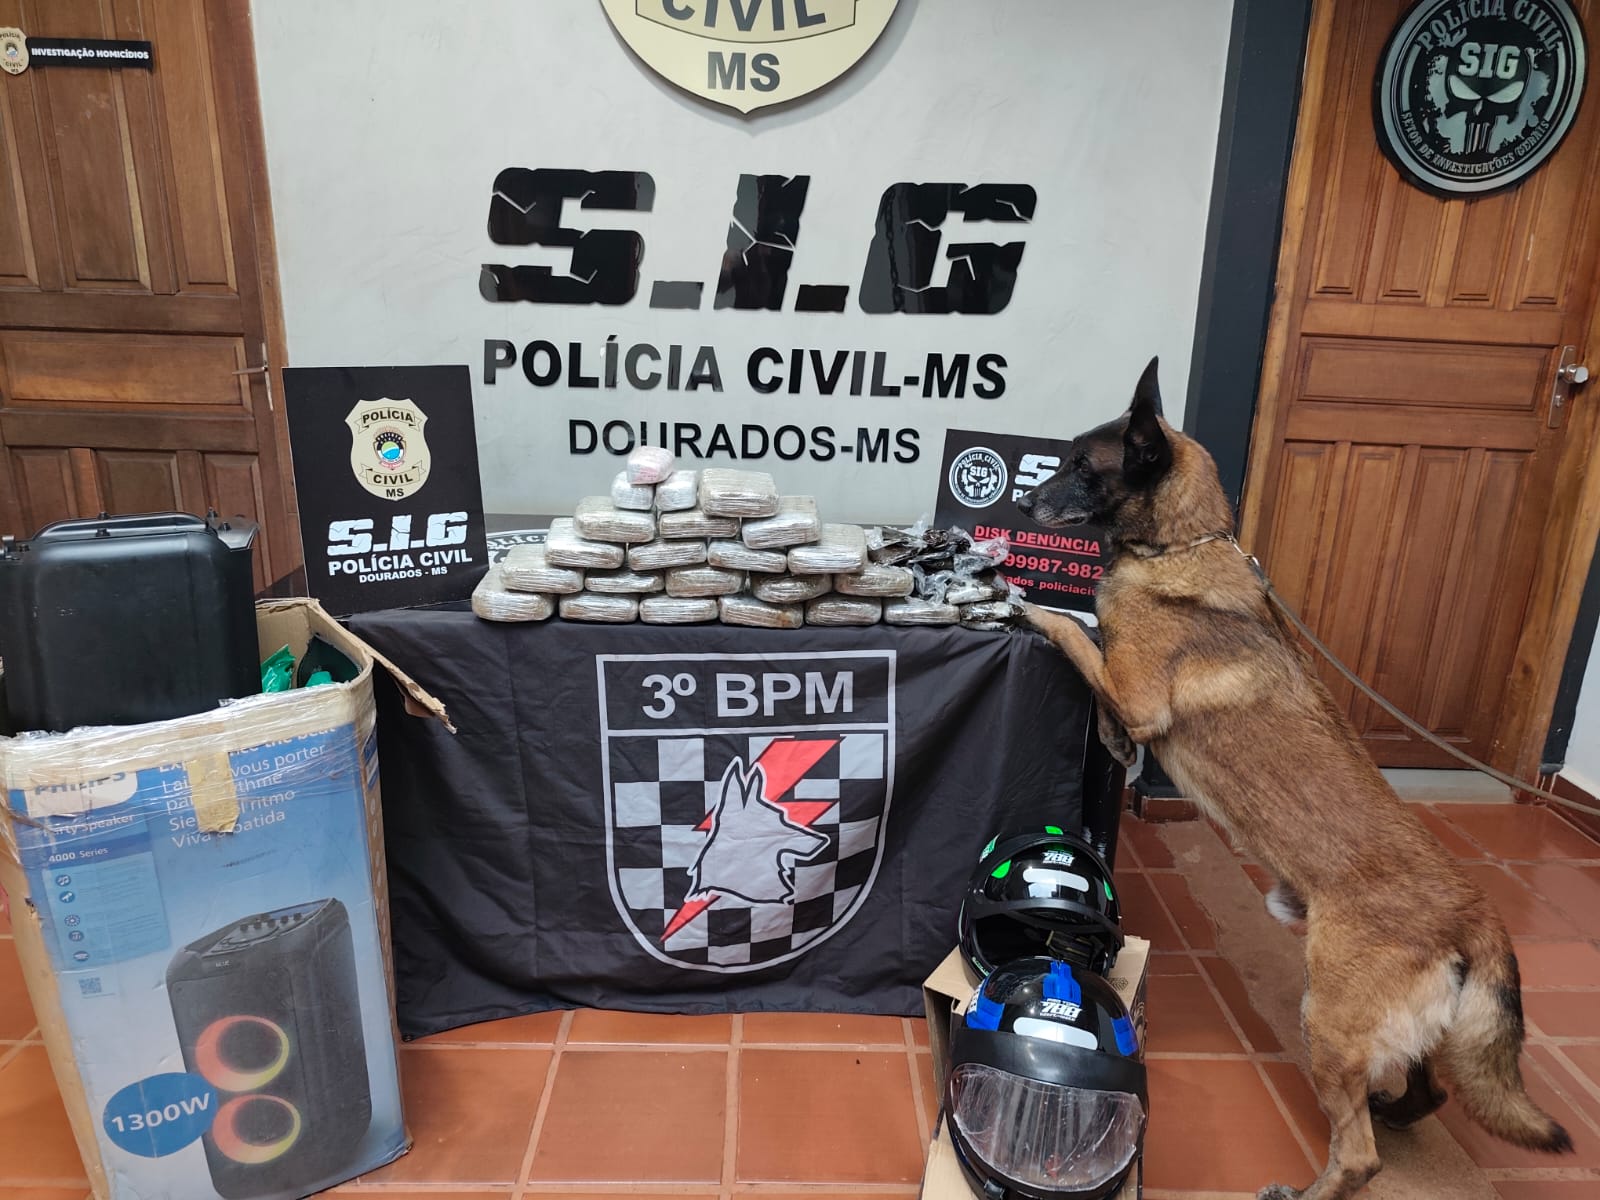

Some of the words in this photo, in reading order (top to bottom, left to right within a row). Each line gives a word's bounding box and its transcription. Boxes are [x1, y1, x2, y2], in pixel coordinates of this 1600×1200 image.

[662, 0, 827, 32] CIVIL
[1416, 0, 1507, 51] POLÍCIA
[1513, 0, 1564, 51] CIVIL
[31, 47, 95, 60] INVESTIGAÇÃO
[96, 48, 149, 59] HOMICÍDIOS
[1458, 42, 1520, 79] SIG
[707, 51, 781, 92] MS
[1400, 110, 1423, 148] SETOR
[1420, 144, 1433, 160] DE
[483, 335, 724, 393] POLÍCIA
[746, 347, 1008, 399] CIVIL-MS
[362, 408, 414, 424] POLÍCIA
[568, 419, 921, 463] DOURADOS-MS
[373, 473, 414, 485] CIVIL
[970, 466, 988, 477] SIG
[386, 488, 404, 498] MS
[975, 525, 1012, 540] DISK
[1016, 531, 1100, 553] DENÚNCIA
[328, 554, 414, 576] POLÍCIA
[419, 549, 473, 566] CIVIL
[359, 569, 422, 583] DOURADOS
[431, 566, 448, 576] MS
[1004, 553, 1104, 580] 99987-982
[716, 671, 854, 718] BPM
[274, 744, 325, 769] porter
[251, 790, 296, 811] ritmo
[81, 814, 135, 832] Speaker
[172, 832, 212, 849] Viva
[48, 852, 76, 862] 4000
[80, 847, 109, 858] Series
[111, 1093, 210, 1134] 1300W
